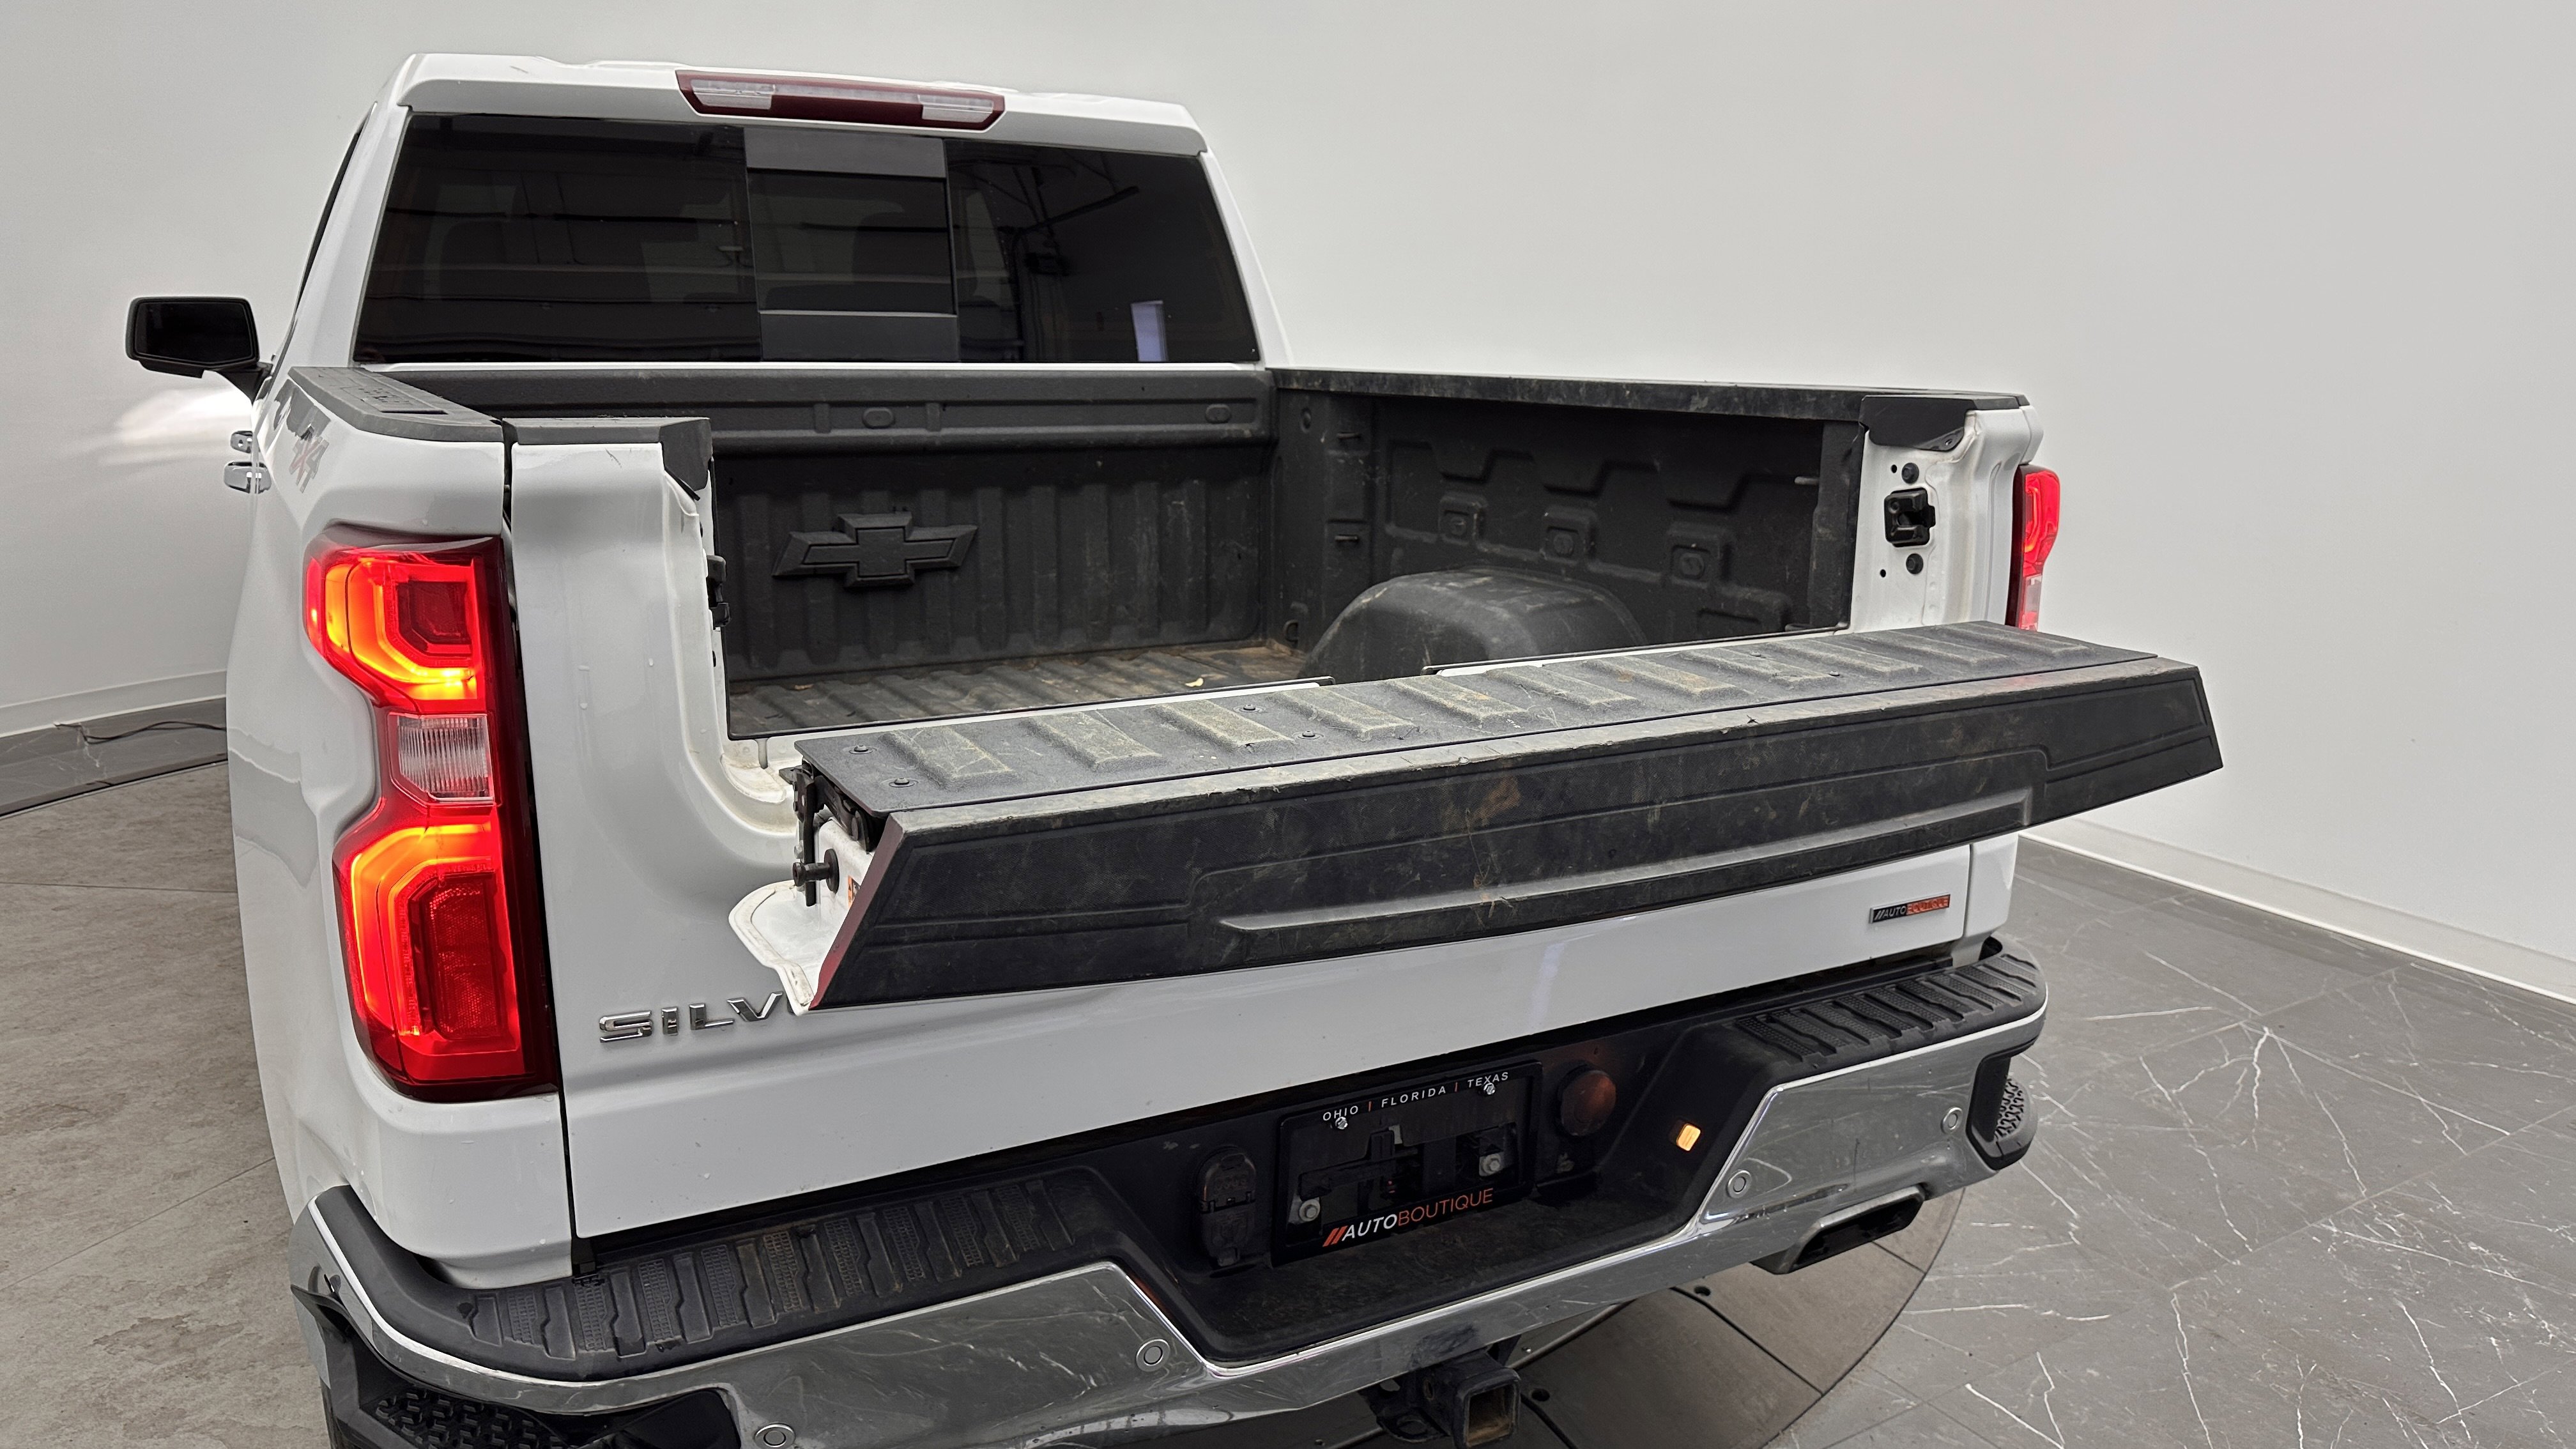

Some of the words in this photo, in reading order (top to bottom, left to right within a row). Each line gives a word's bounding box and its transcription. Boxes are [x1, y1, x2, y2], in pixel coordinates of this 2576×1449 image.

[599, 990, 796, 1044] SILV
[1322, 1105, 1359, 1121] OHIO
[1381, 1085, 1446, 1108] FLORIDA
[1468, 1071, 1509, 1089] TEXAS
